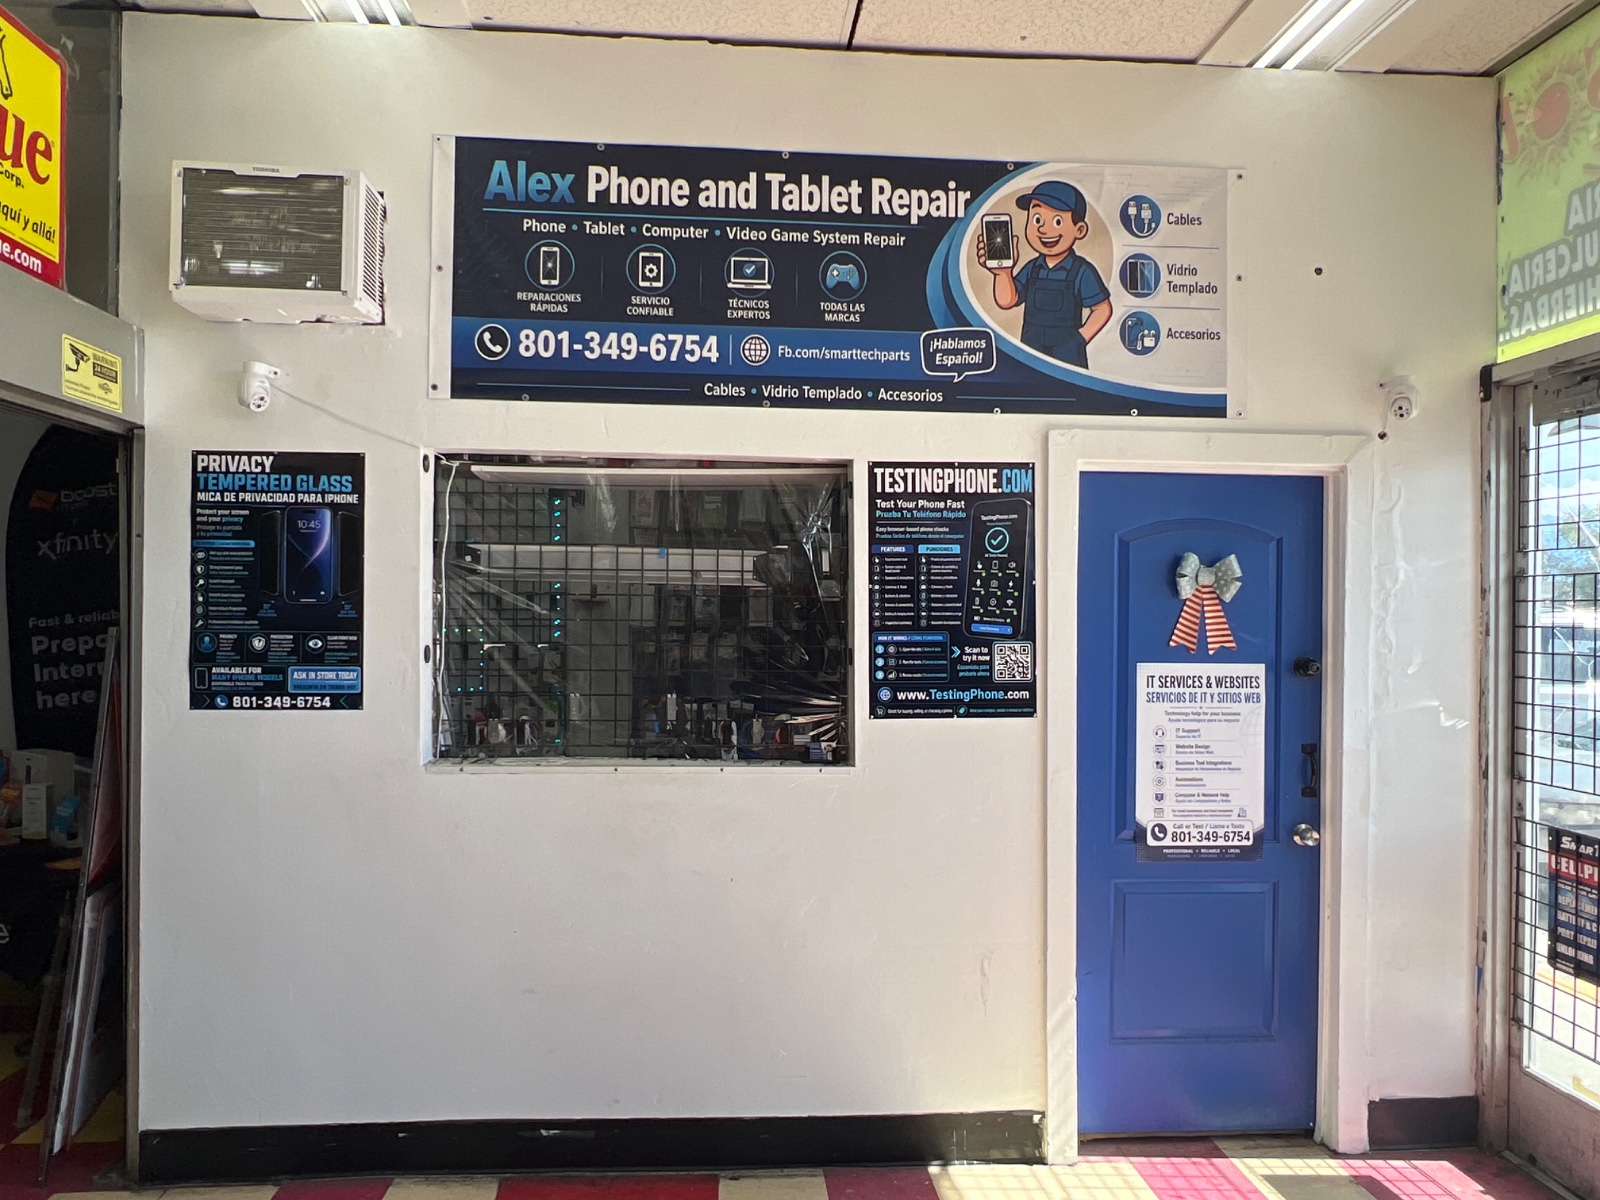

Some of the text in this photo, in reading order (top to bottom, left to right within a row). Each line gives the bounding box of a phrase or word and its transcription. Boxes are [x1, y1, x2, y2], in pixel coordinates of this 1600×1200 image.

[484, 160, 971, 225] Alex Phone and Tablet Repair
[1167, 212, 1202, 226] Cables
[23, 215, 30, 231] y
[31, 220, 55, 243] allá!
[523, 218, 906, 248] Phone Tablet Computer Video Game System Repair
[1166, 263, 1198, 276] Vidrio
[1166, 281, 1218, 296] Templado
[517, 292, 582, 303] REPARACIONES
[631, 295, 670, 306] SERVICIO
[728, 297, 770, 309] TÉCNICOS
[530, 302, 568, 313] RÁPIDAS
[627, 306, 674, 317] CONFIABLE
[820, 301, 865, 312] TODAS LAS
[727, 308, 771, 320] EXPERTOS
[824, 312, 861, 323] MARCAS
[1166, 327, 1221, 340] Accesorios
[518, 328, 719, 363] 801-349-6754
[929, 337, 987, 351] ¡Hablamos
[778, 346, 911, 363] Fb.com/smarttechparts
[935, 351, 983, 366] Español!
[704, 382, 943, 402] Cables Vidrio Templado Accesorios
[197, 454, 275, 473] PRIVACY
[197, 473, 353, 493] TEMPERED GLASS
[874, 468, 1032, 493] TESTINGPHONE.COM
[60, 482, 117, 503] boost
[197, 492, 359, 504] MICA DE PRIVACIDAD PARA IPHONE
[876, 500, 965, 508] Test Your Phone Fast
[876, 510, 966, 519] Prueba Tu Teléfono Rápido
[297, 520, 321, 529] 10:45
[37, 528, 119, 561] xfinity
[29, 617, 60, 629] Fast
[65, 614, 74, 625] &
[293, 671, 357, 680] ASK IN STORE TODAY
[1146, 675, 1260, 689] IT SERVICES & WEBSITES
[897, 689, 1030, 702] www.TestingPhone.com
[1146, 692, 1261, 703] SERVICIOS DE IT Y SITIOS WEB
[233, 696, 331, 709] 801-349-6754
[1171, 831, 1250, 842] 801-349-6754
